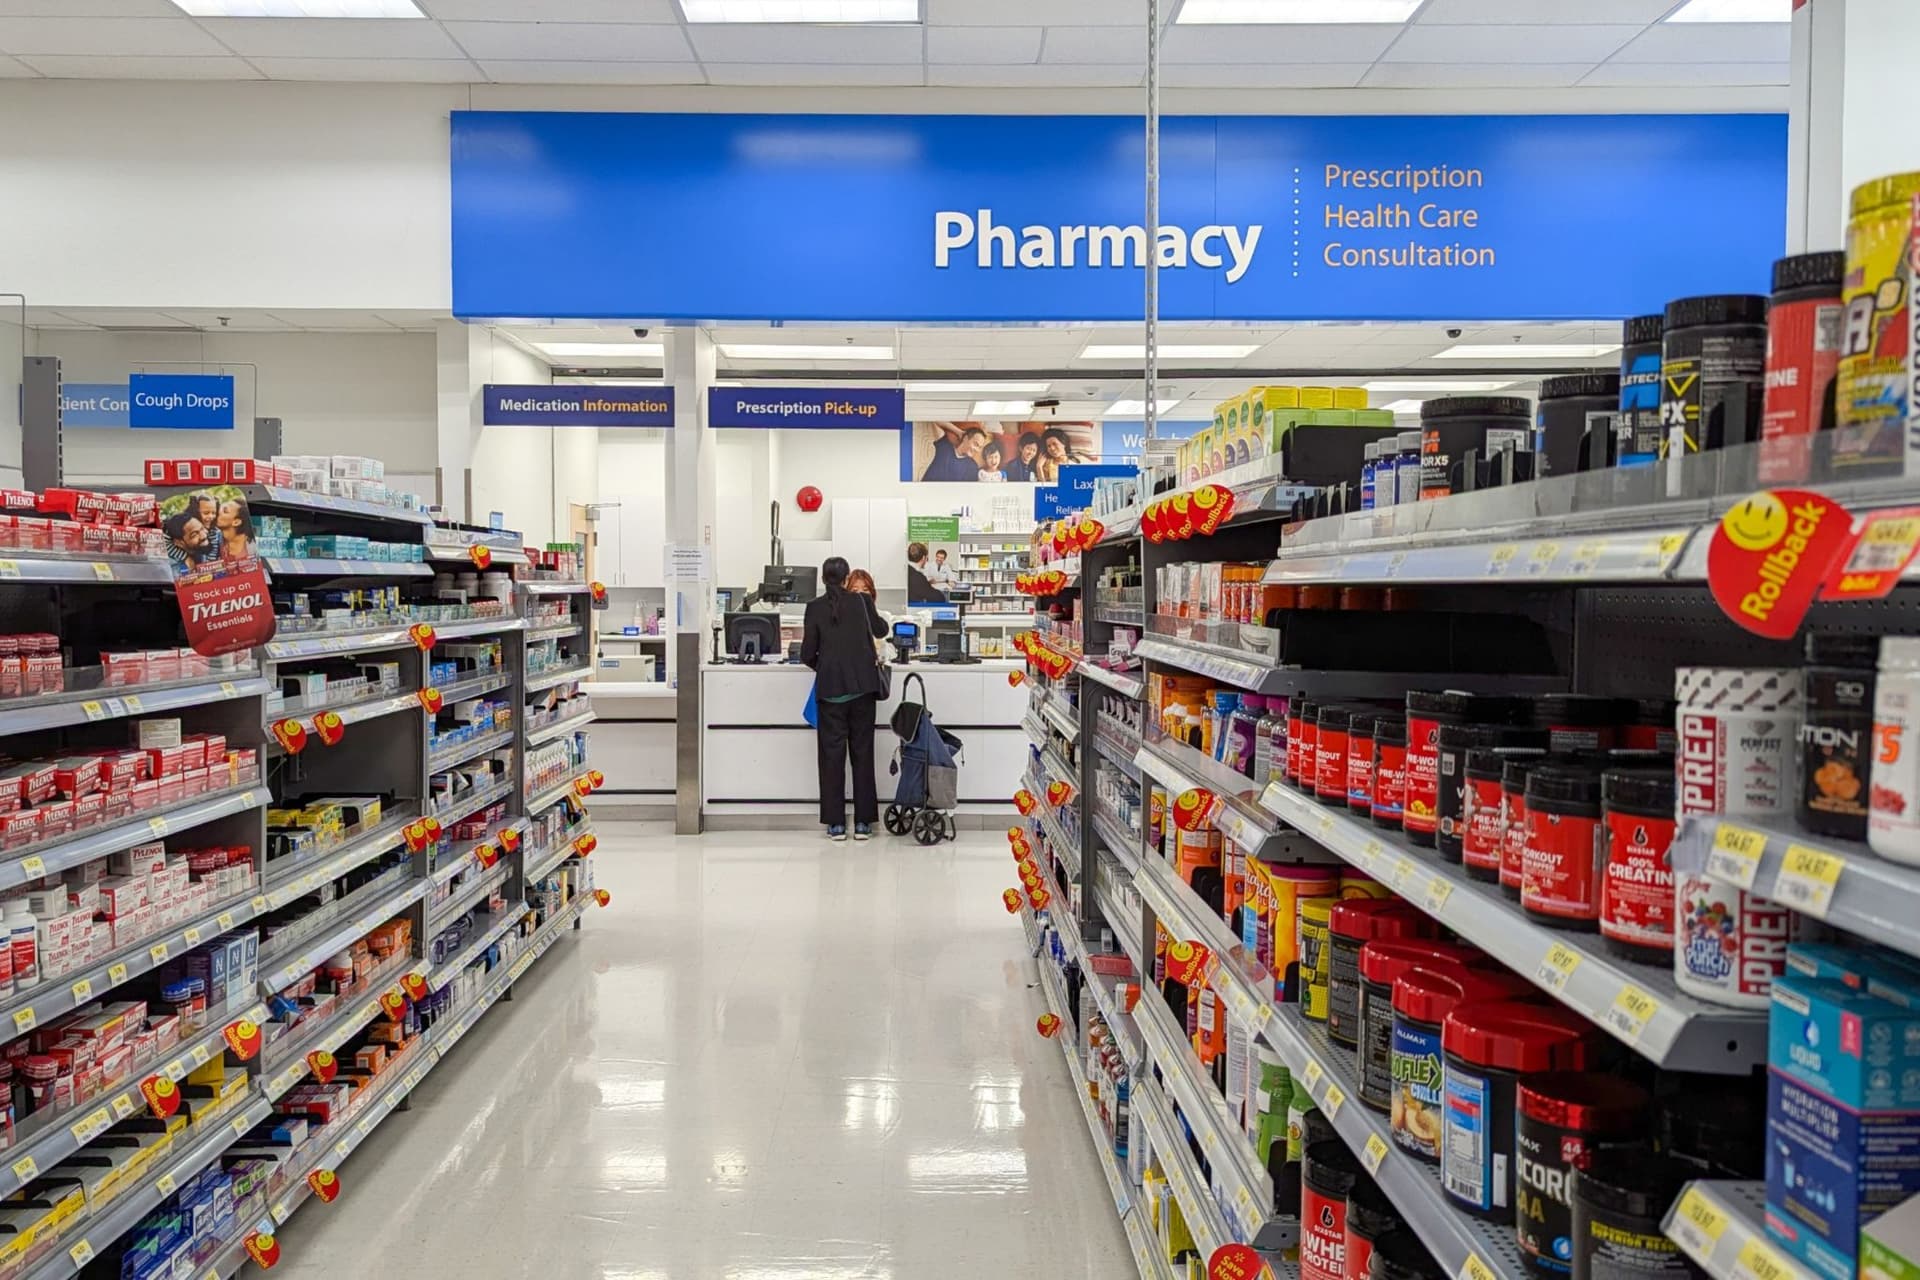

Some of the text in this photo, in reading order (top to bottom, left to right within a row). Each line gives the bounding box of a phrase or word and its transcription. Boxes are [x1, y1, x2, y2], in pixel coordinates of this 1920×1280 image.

[1325, 164, 1484, 193] Prescription
[1325, 205, 1478, 229] Health Care
[934, 209, 1263, 284] Pharmacy
[1324, 242, 1495, 269] Consultation
[135, 392, 229, 411] Cough Drops
[500, 398, 668, 413] Medication Information
[736, 400, 877, 417] Prescription Pick-up
[3, 492, 35, 507] TYLENOL
[1200, 491, 1231, 535] Rollback
[1739, 500, 1828, 621] Rollback
[193, 582, 251, 601] Stock up on
[187, 593, 264, 623] TYLENOL
[206, 613, 253, 632] Essentials
[1185, 792, 1211, 831] Rollback
[132, 847, 163, 859] TYLENOL
[1627, 856, 1655, 869] 100%
[232, 949, 240, 966] N
[247, 940, 255, 957] N
[215, 957, 223, 974] N
[1180, 946, 1205, 982] Rollback
[226, 1027, 249, 1059] Rollback
[142, 1082, 167, 1119] Rollback
[245, 1239, 269, 1269] Rollback
[1220, 1255, 1245, 1277] Save
